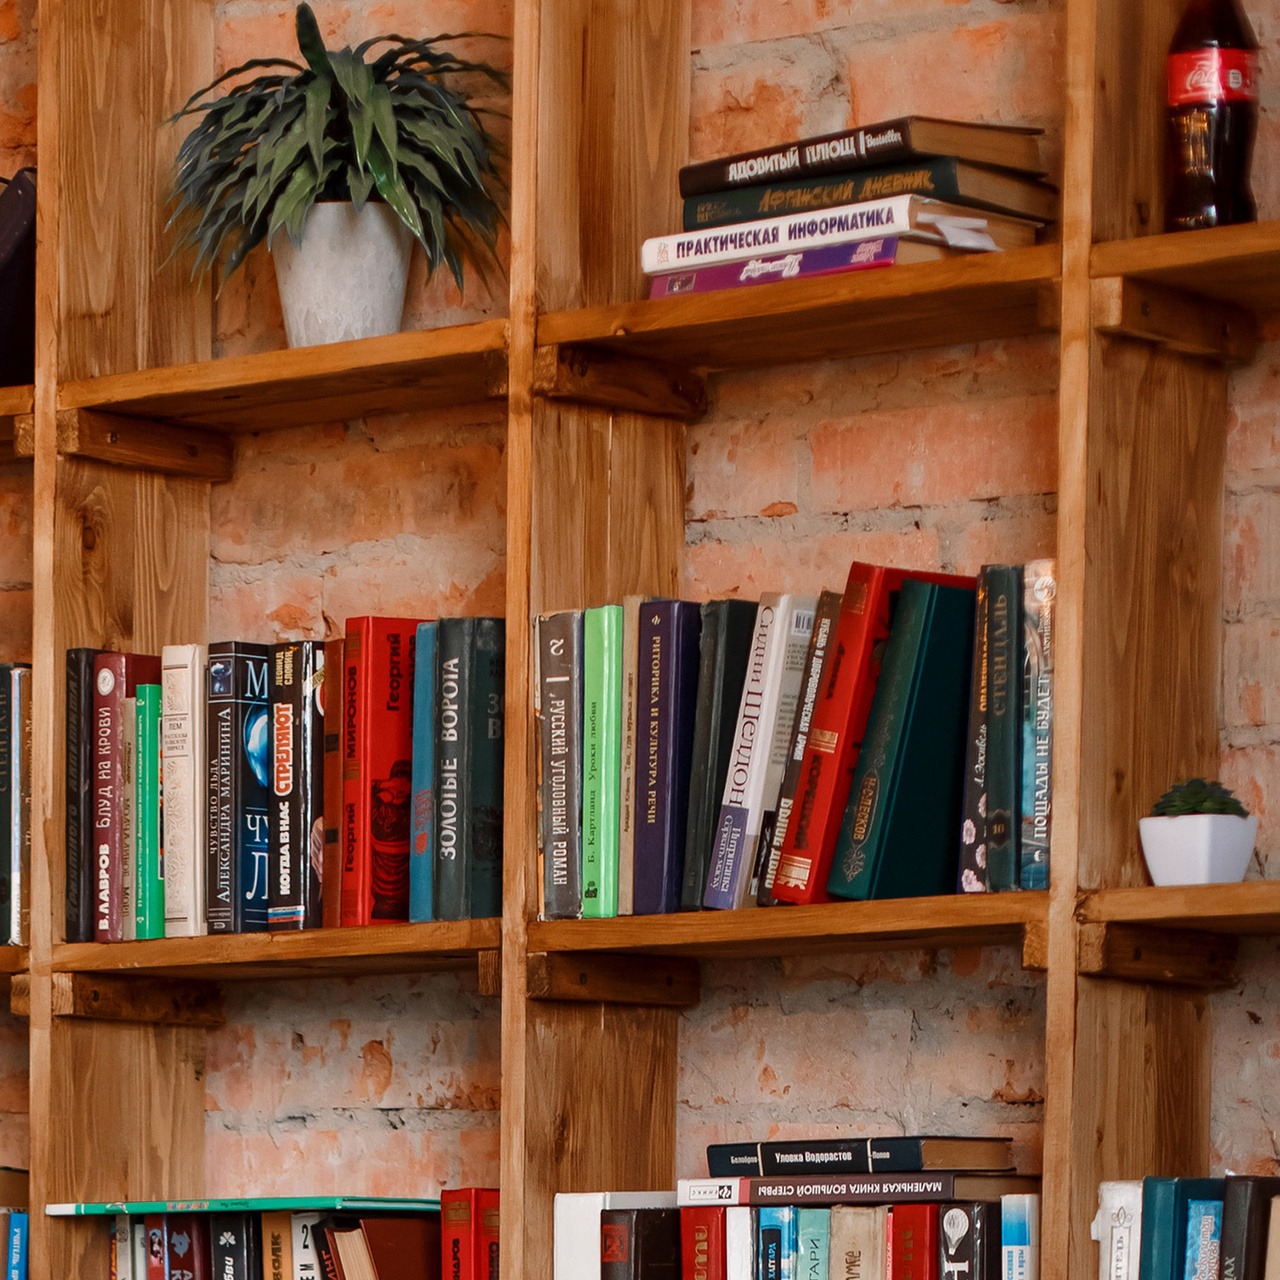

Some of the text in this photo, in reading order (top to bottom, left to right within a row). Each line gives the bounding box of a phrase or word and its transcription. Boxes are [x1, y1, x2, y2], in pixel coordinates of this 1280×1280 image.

[727, 136, 858, 182] ЯДОВИТЫЙ ПЛЮЩ
[676, 205, 896, 260] ПРАКТИЧЕСКАЯ ИНФОРМАТИКА
[386, 633, 402, 712] Георгий
[649, 635, 661, 701] РИТОРИКА
[793, 616, 831, 761] КУБАНЬ ДОБРОВОЛЬЧЕСКАЯ АРМИЯ
[1037, 674, 1053, 732] БУДЕТ
[731, 606, 775, 808] Сидни Шелдон
[274, 702, 293, 797] СТРЕЛЯЮТ
[345, 664, 358, 873] Георгий МИРОНОВ
[439, 656, 460, 862] ЗОЛОТЫЕ ВОРОТА
[587, 700, 598, 850] Картланд Уроки любви
[648, 719, 660, 786] КУЛЬТУРА
[1036, 733, 1050, 762] НЕ
[210, 758, 219, 854] ЧУВСТВО ЛЬДА
[217, 706, 231, 903] АЛЕКСАНДРА МАРИНИНА
[552, 699, 568, 887] РУССКИЙ УГОЛОВНЫЙ РОМАН
[647, 789, 658, 825] РЕЧИ
[1033, 764, 1049, 840] ПОЩАДЫ
[280, 801, 291, 895] КОГДА НАС
[757, 1181, 942, 1199] МАЛЕНЬКАЯ КНИГА БОЛЬШОЙ СТЕРВЫ
[774, 1150, 852, 1165] Уловка Водорастов
[301, 1223, 309, 1250] 2
